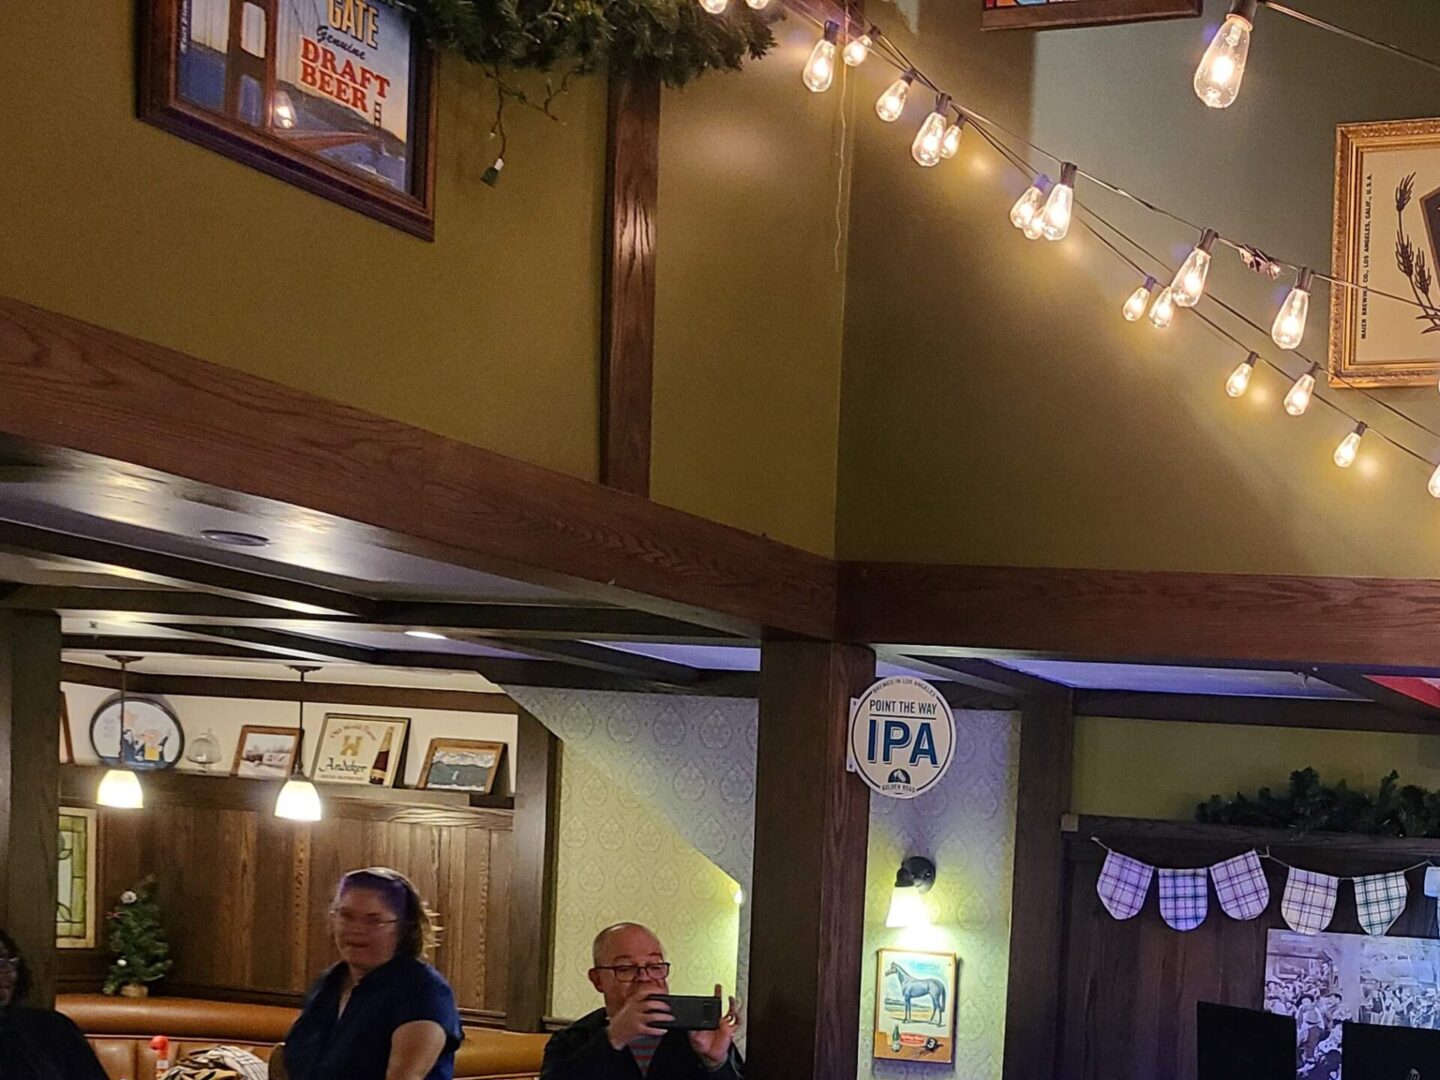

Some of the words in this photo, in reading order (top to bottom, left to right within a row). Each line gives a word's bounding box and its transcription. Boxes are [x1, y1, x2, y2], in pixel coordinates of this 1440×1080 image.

[316, 25, 366, 60] Genuine
[300, 37, 391, 98] DRAFT
[300, 62, 369, 113] BEER
[869, 699, 896, 712] POINT
[899, 701, 915, 714] THE
[918, 702, 937, 715] WAY
[868, 720, 939, 768] IPA
[927, 1039, 936, 1049] 3
